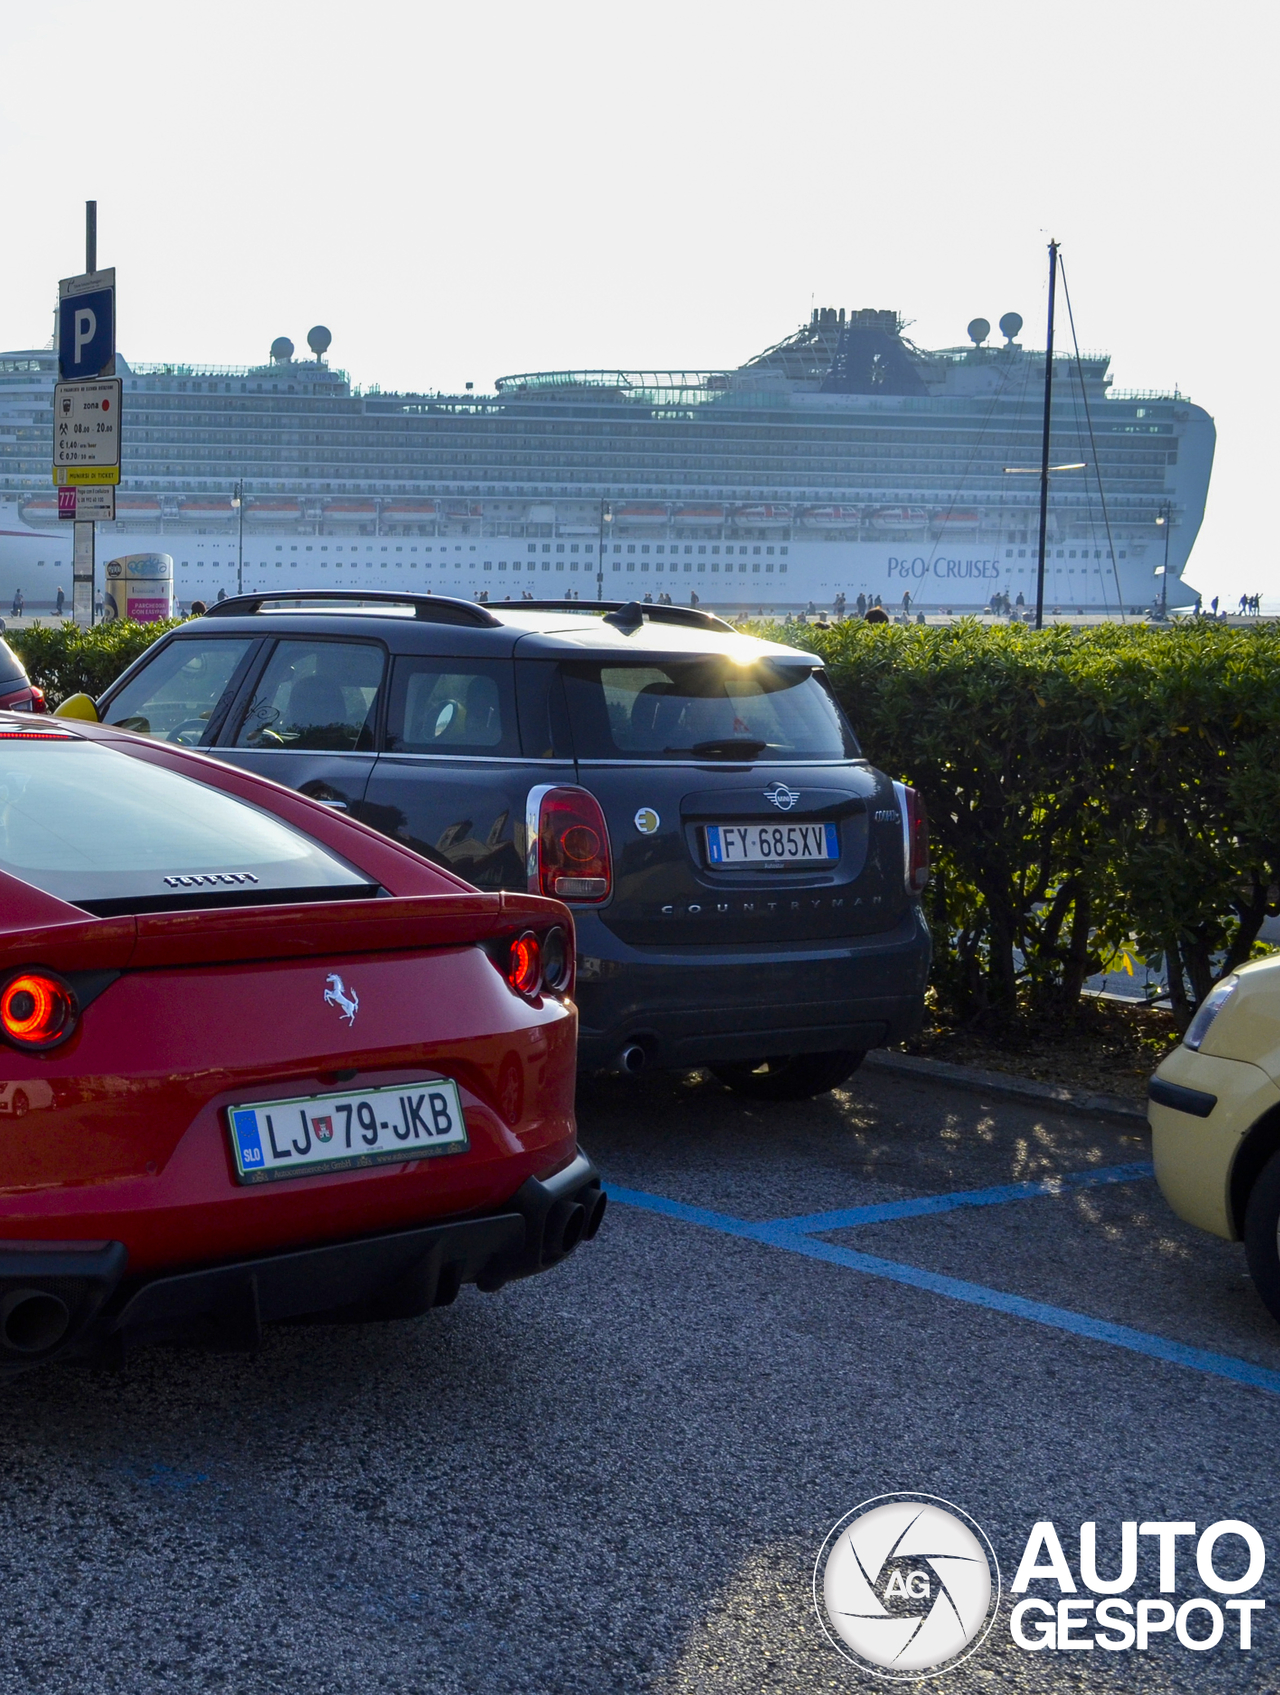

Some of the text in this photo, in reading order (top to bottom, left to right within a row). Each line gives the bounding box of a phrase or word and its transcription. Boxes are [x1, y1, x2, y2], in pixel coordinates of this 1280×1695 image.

[73, 308, 97, 364] P
[83, 402, 99, 410] zona
[73, 423, 90, 434] 08.00
[96, 422, 113, 433] 20.00
[59, 491, 77, 507] 777
[887, 557, 1000, 579] P&O CRUISES
[722, 828, 748, 858] FY
[758, 826, 823, 857] 685XV
[661, 896, 883, 914] COUNTRYMAN
[266, 1092, 453, 1159] LJ 79-JKB
[243, 1147, 261, 1163] SLO
[330, 1159, 352, 1170] GmbH
